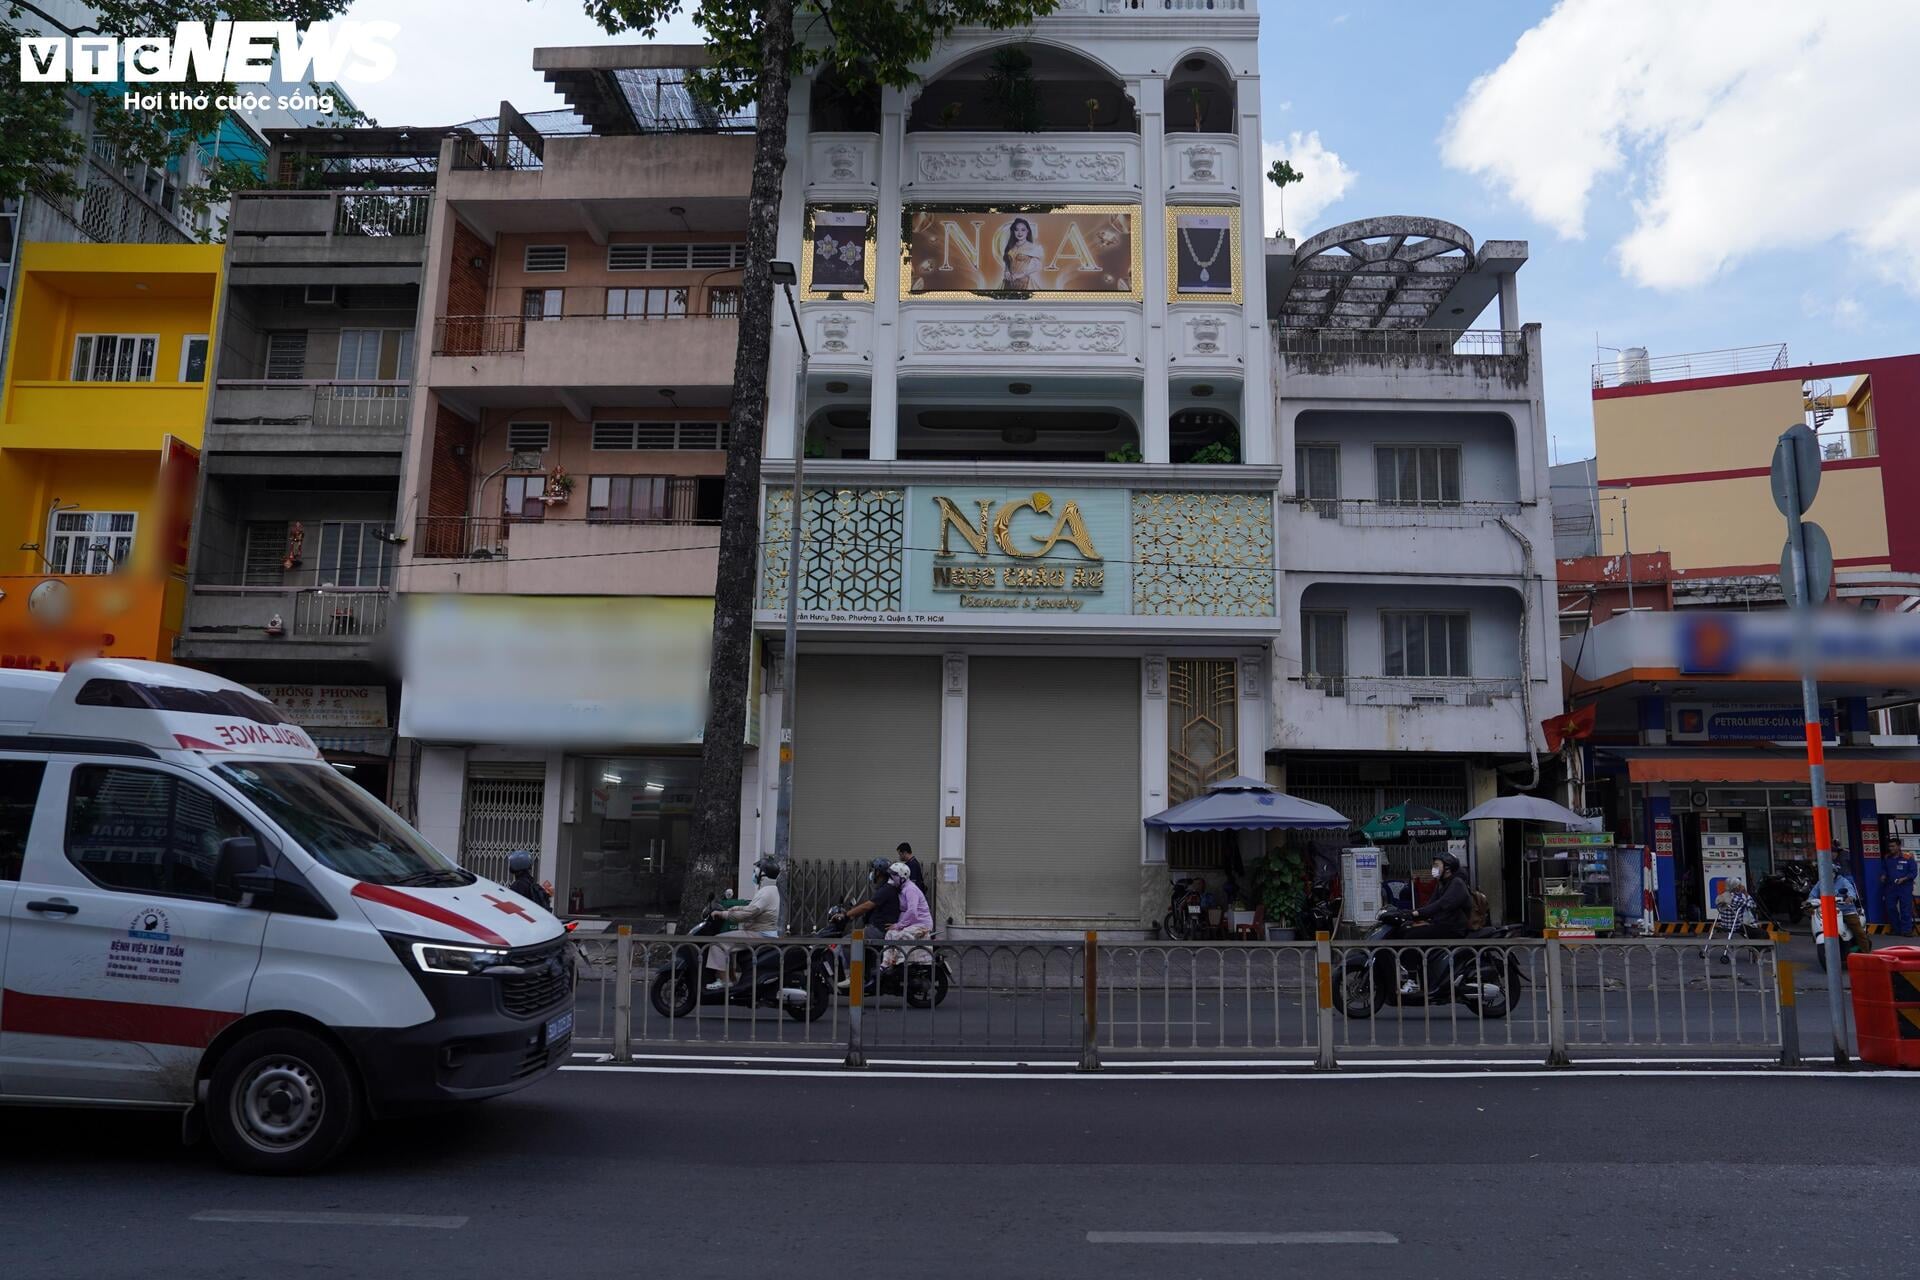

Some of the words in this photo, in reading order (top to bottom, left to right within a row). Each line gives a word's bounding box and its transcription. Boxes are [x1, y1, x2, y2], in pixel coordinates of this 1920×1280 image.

[1003, 564, 1065, 588] CHÂU
[1072, 564, 1104, 588] ÂU
[848, 614, 877, 623] Phường
[886, 615, 905, 624] Quận
[915, 615, 925, 623] TP.
[110, 939, 130, 953] BỆNH
[131, 941, 147, 955] VIỆN
[149, 943, 165, 955] TÂM
